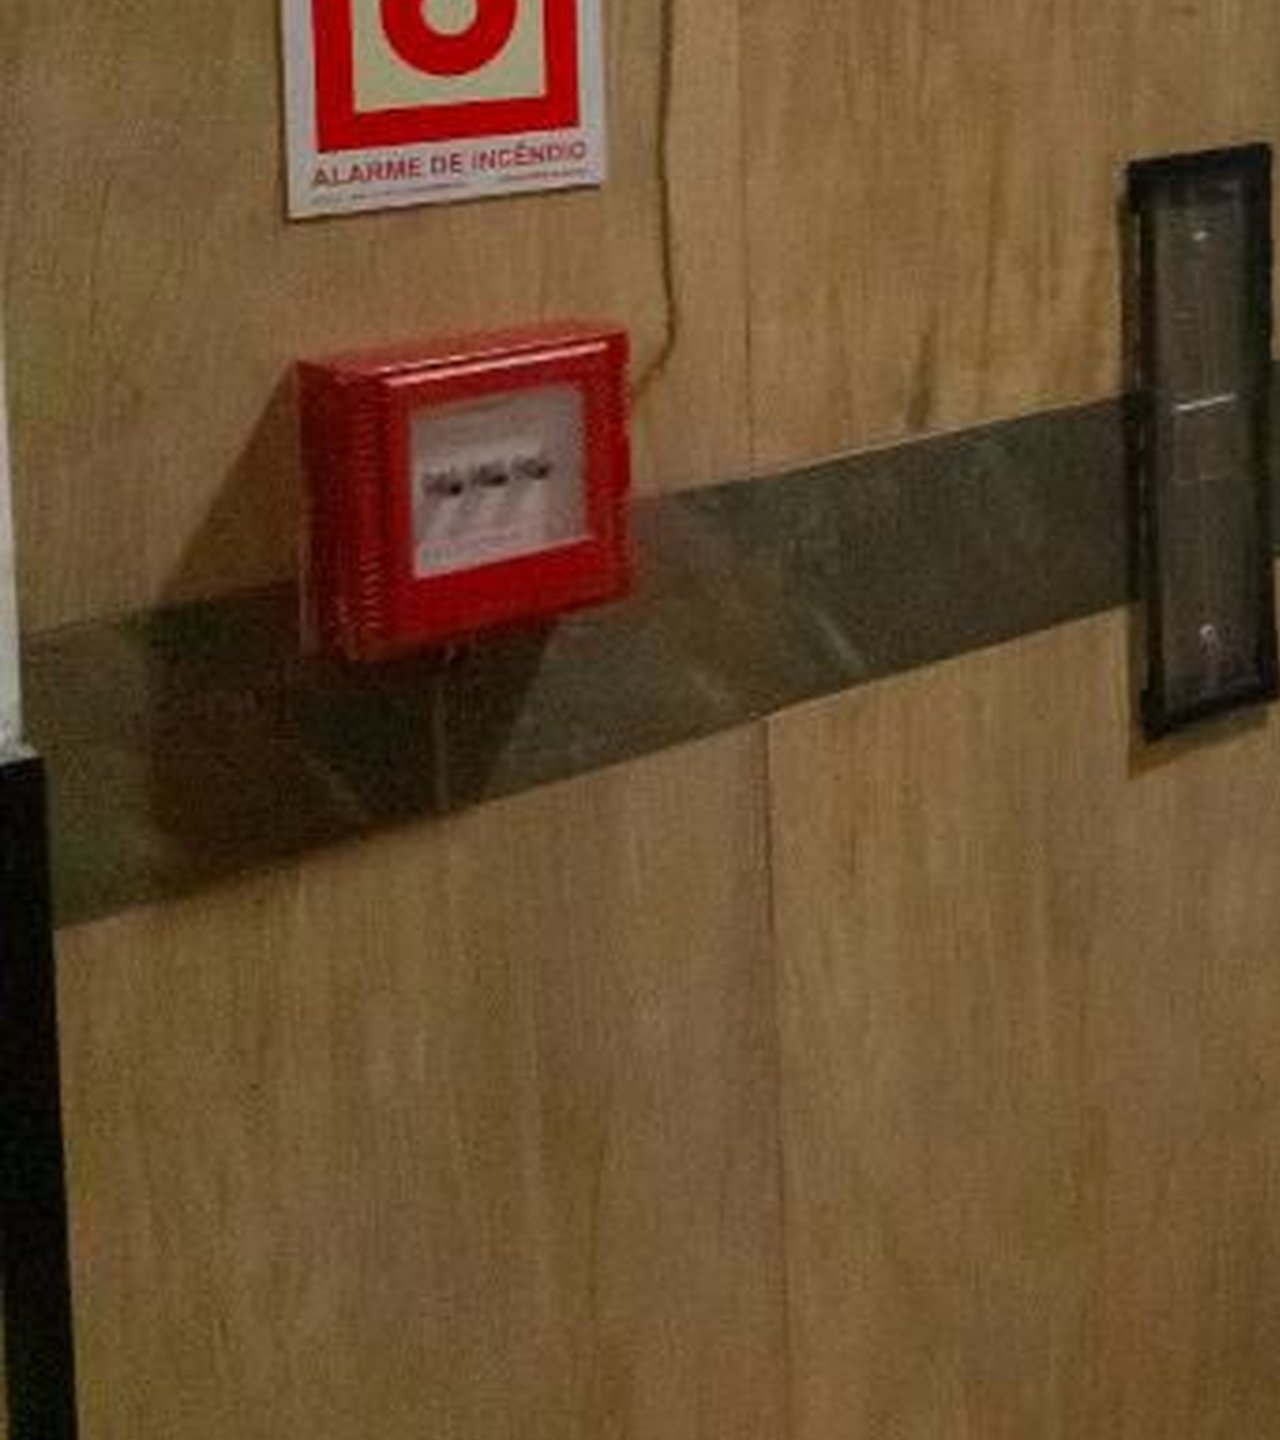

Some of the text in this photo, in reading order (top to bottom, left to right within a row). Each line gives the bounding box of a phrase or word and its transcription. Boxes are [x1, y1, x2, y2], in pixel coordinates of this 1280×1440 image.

[311, 139, 588, 187] ALARME DE INCÊNDIO
